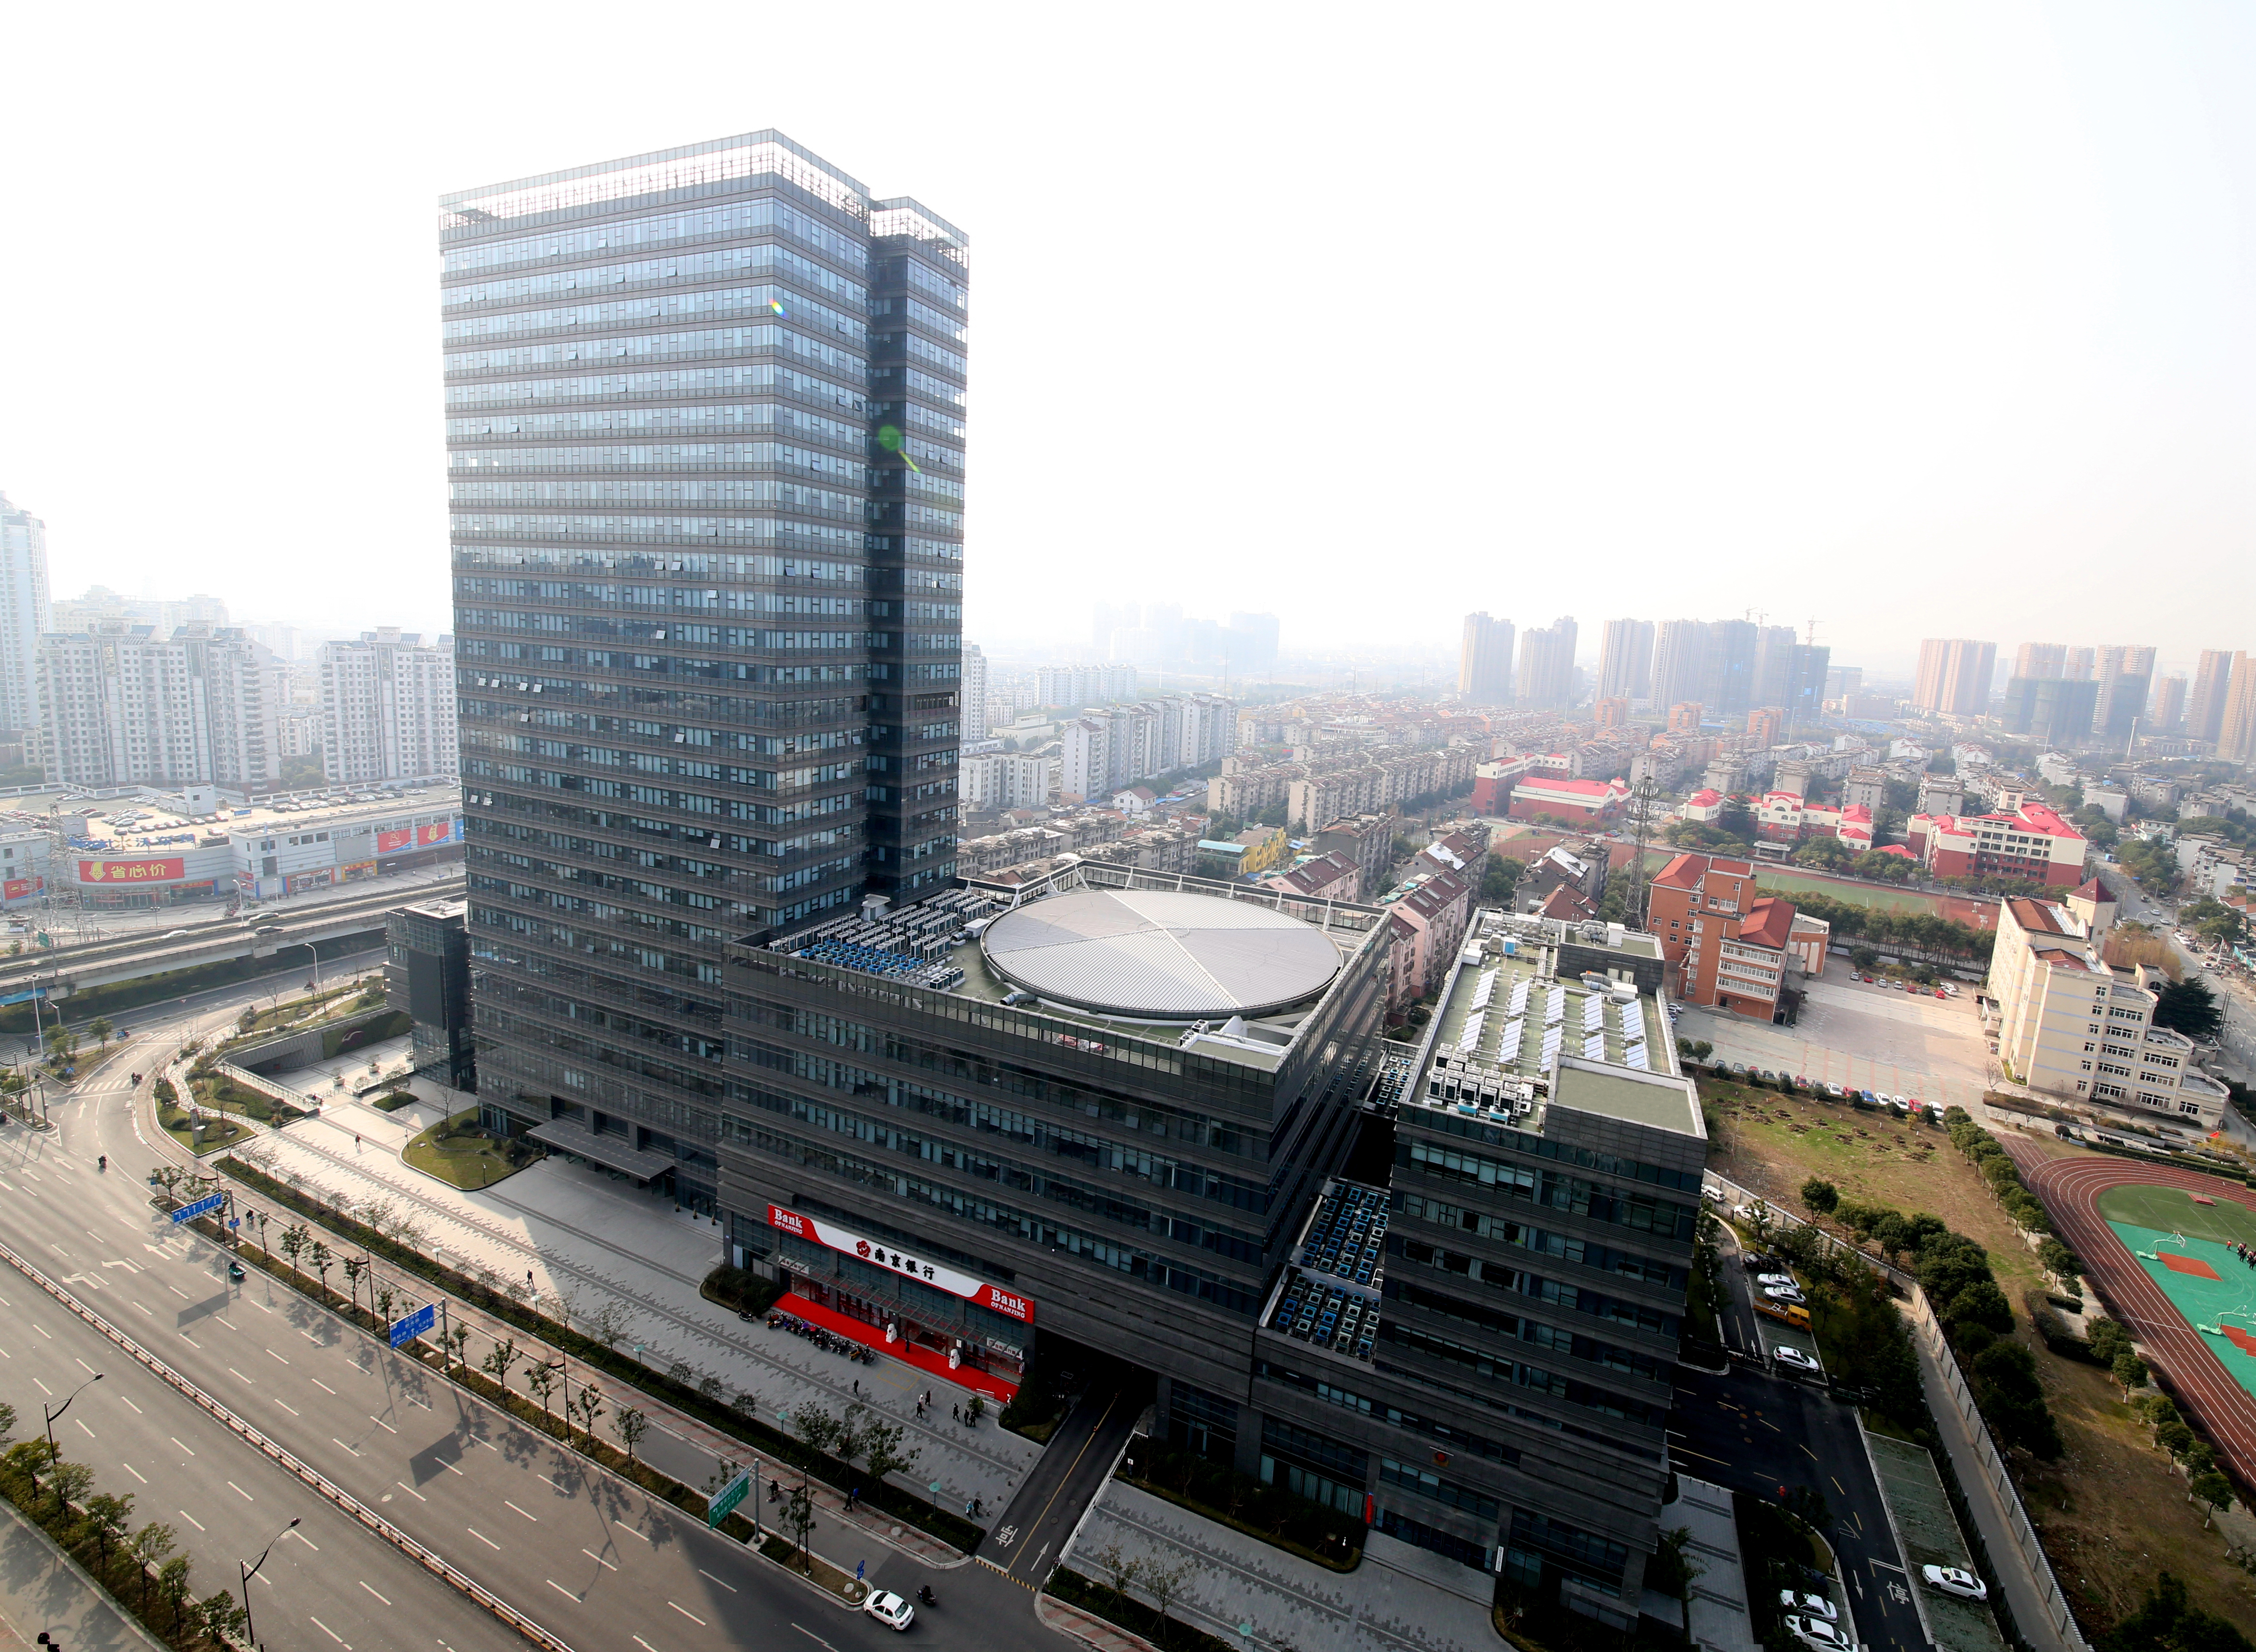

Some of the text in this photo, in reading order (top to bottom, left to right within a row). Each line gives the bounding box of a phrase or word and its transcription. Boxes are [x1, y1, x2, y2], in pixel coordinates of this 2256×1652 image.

[111, 863, 166, 878] 省心价
[774, 1208, 803, 1228] Bank
[781, 1222, 803, 1234] NANJING
[874, 1248, 934, 1280] 南京银行
[991, 1288, 1026, 1312] Bank
[999, 1304, 1025, 1318] NANJING
[995, 1525, 1018, 1547] 停
[1887, 1581, 1910, 1605] 停
